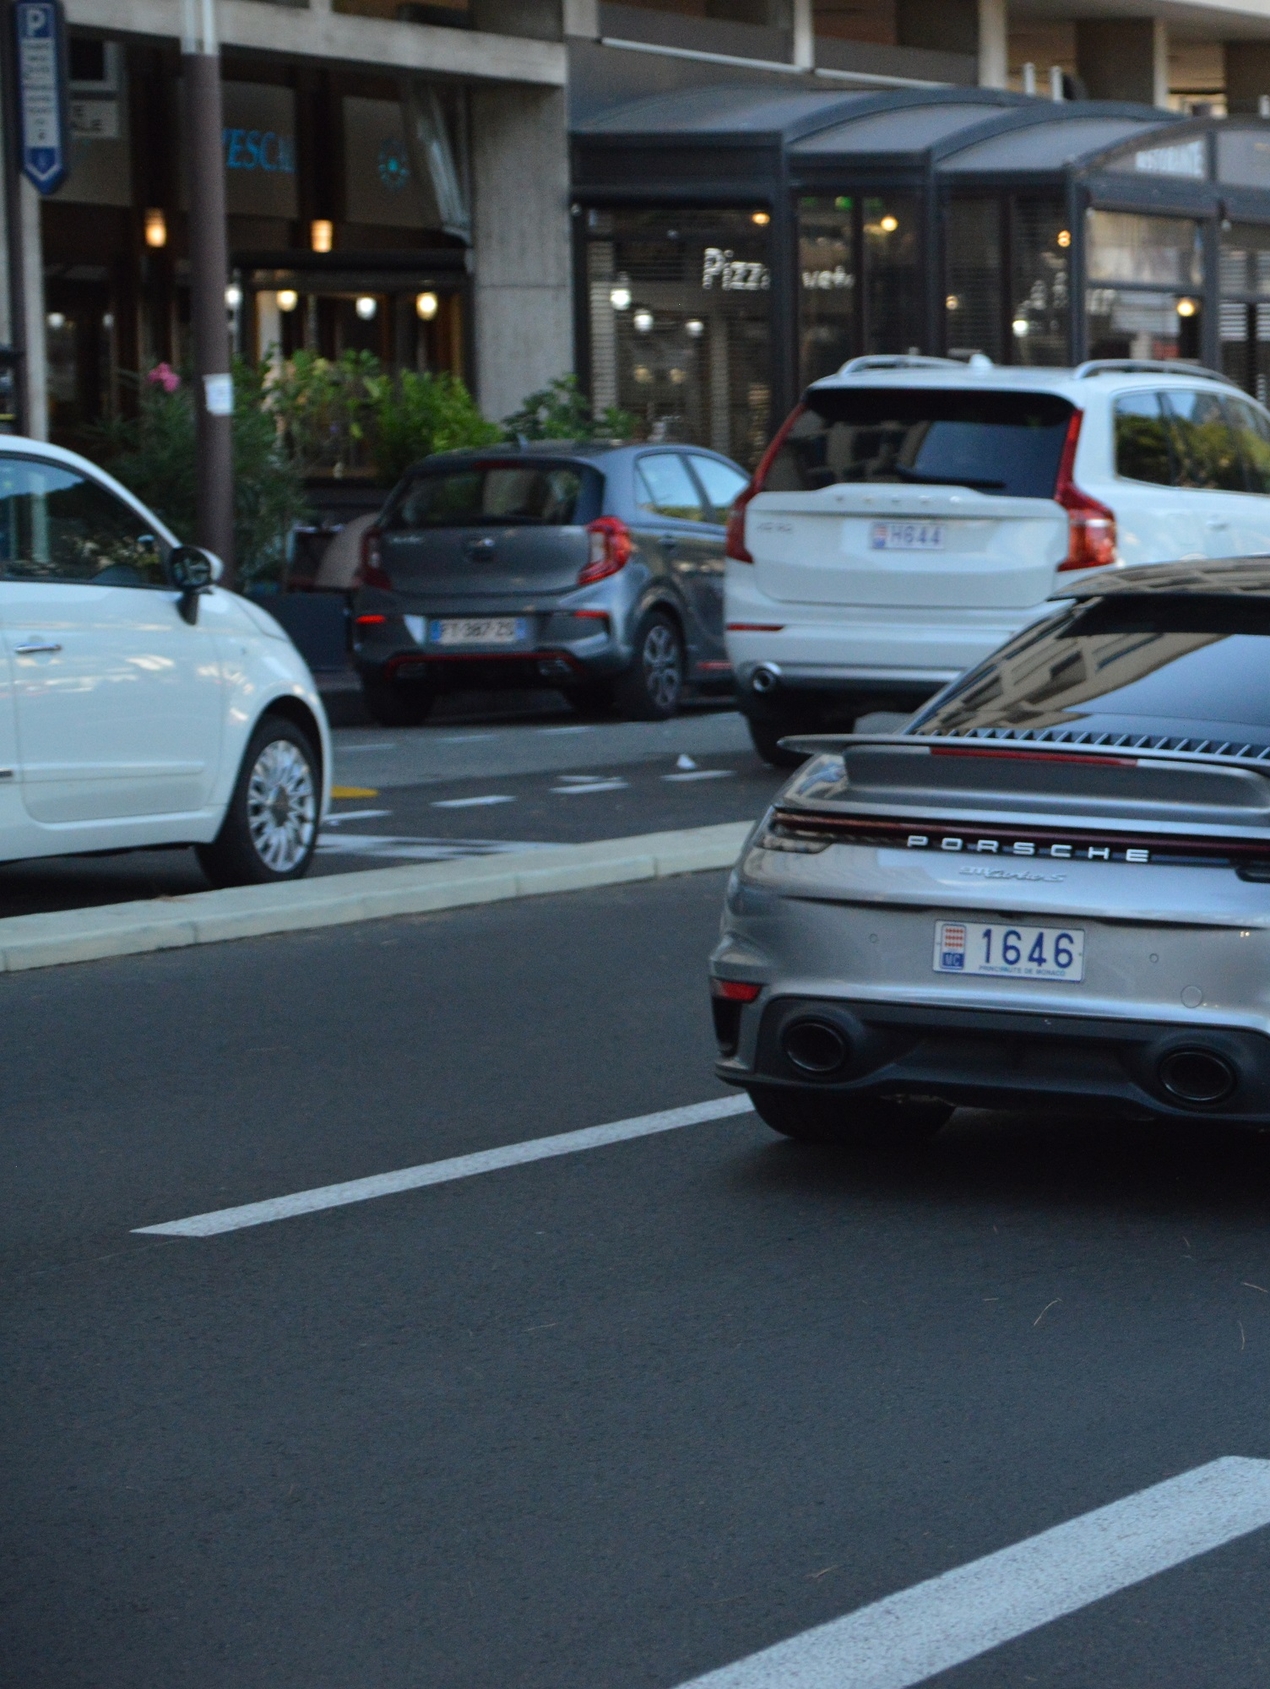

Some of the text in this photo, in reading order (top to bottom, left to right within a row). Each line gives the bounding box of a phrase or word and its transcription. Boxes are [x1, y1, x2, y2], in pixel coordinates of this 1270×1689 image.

[26, 9, 46, 36] P
[890, 524, 942, 545] H644
[907, 835, 1149, 862] PORSCHE
[945, 952, 962, 967] MC
[981, 927, 1075, 969] 1646
